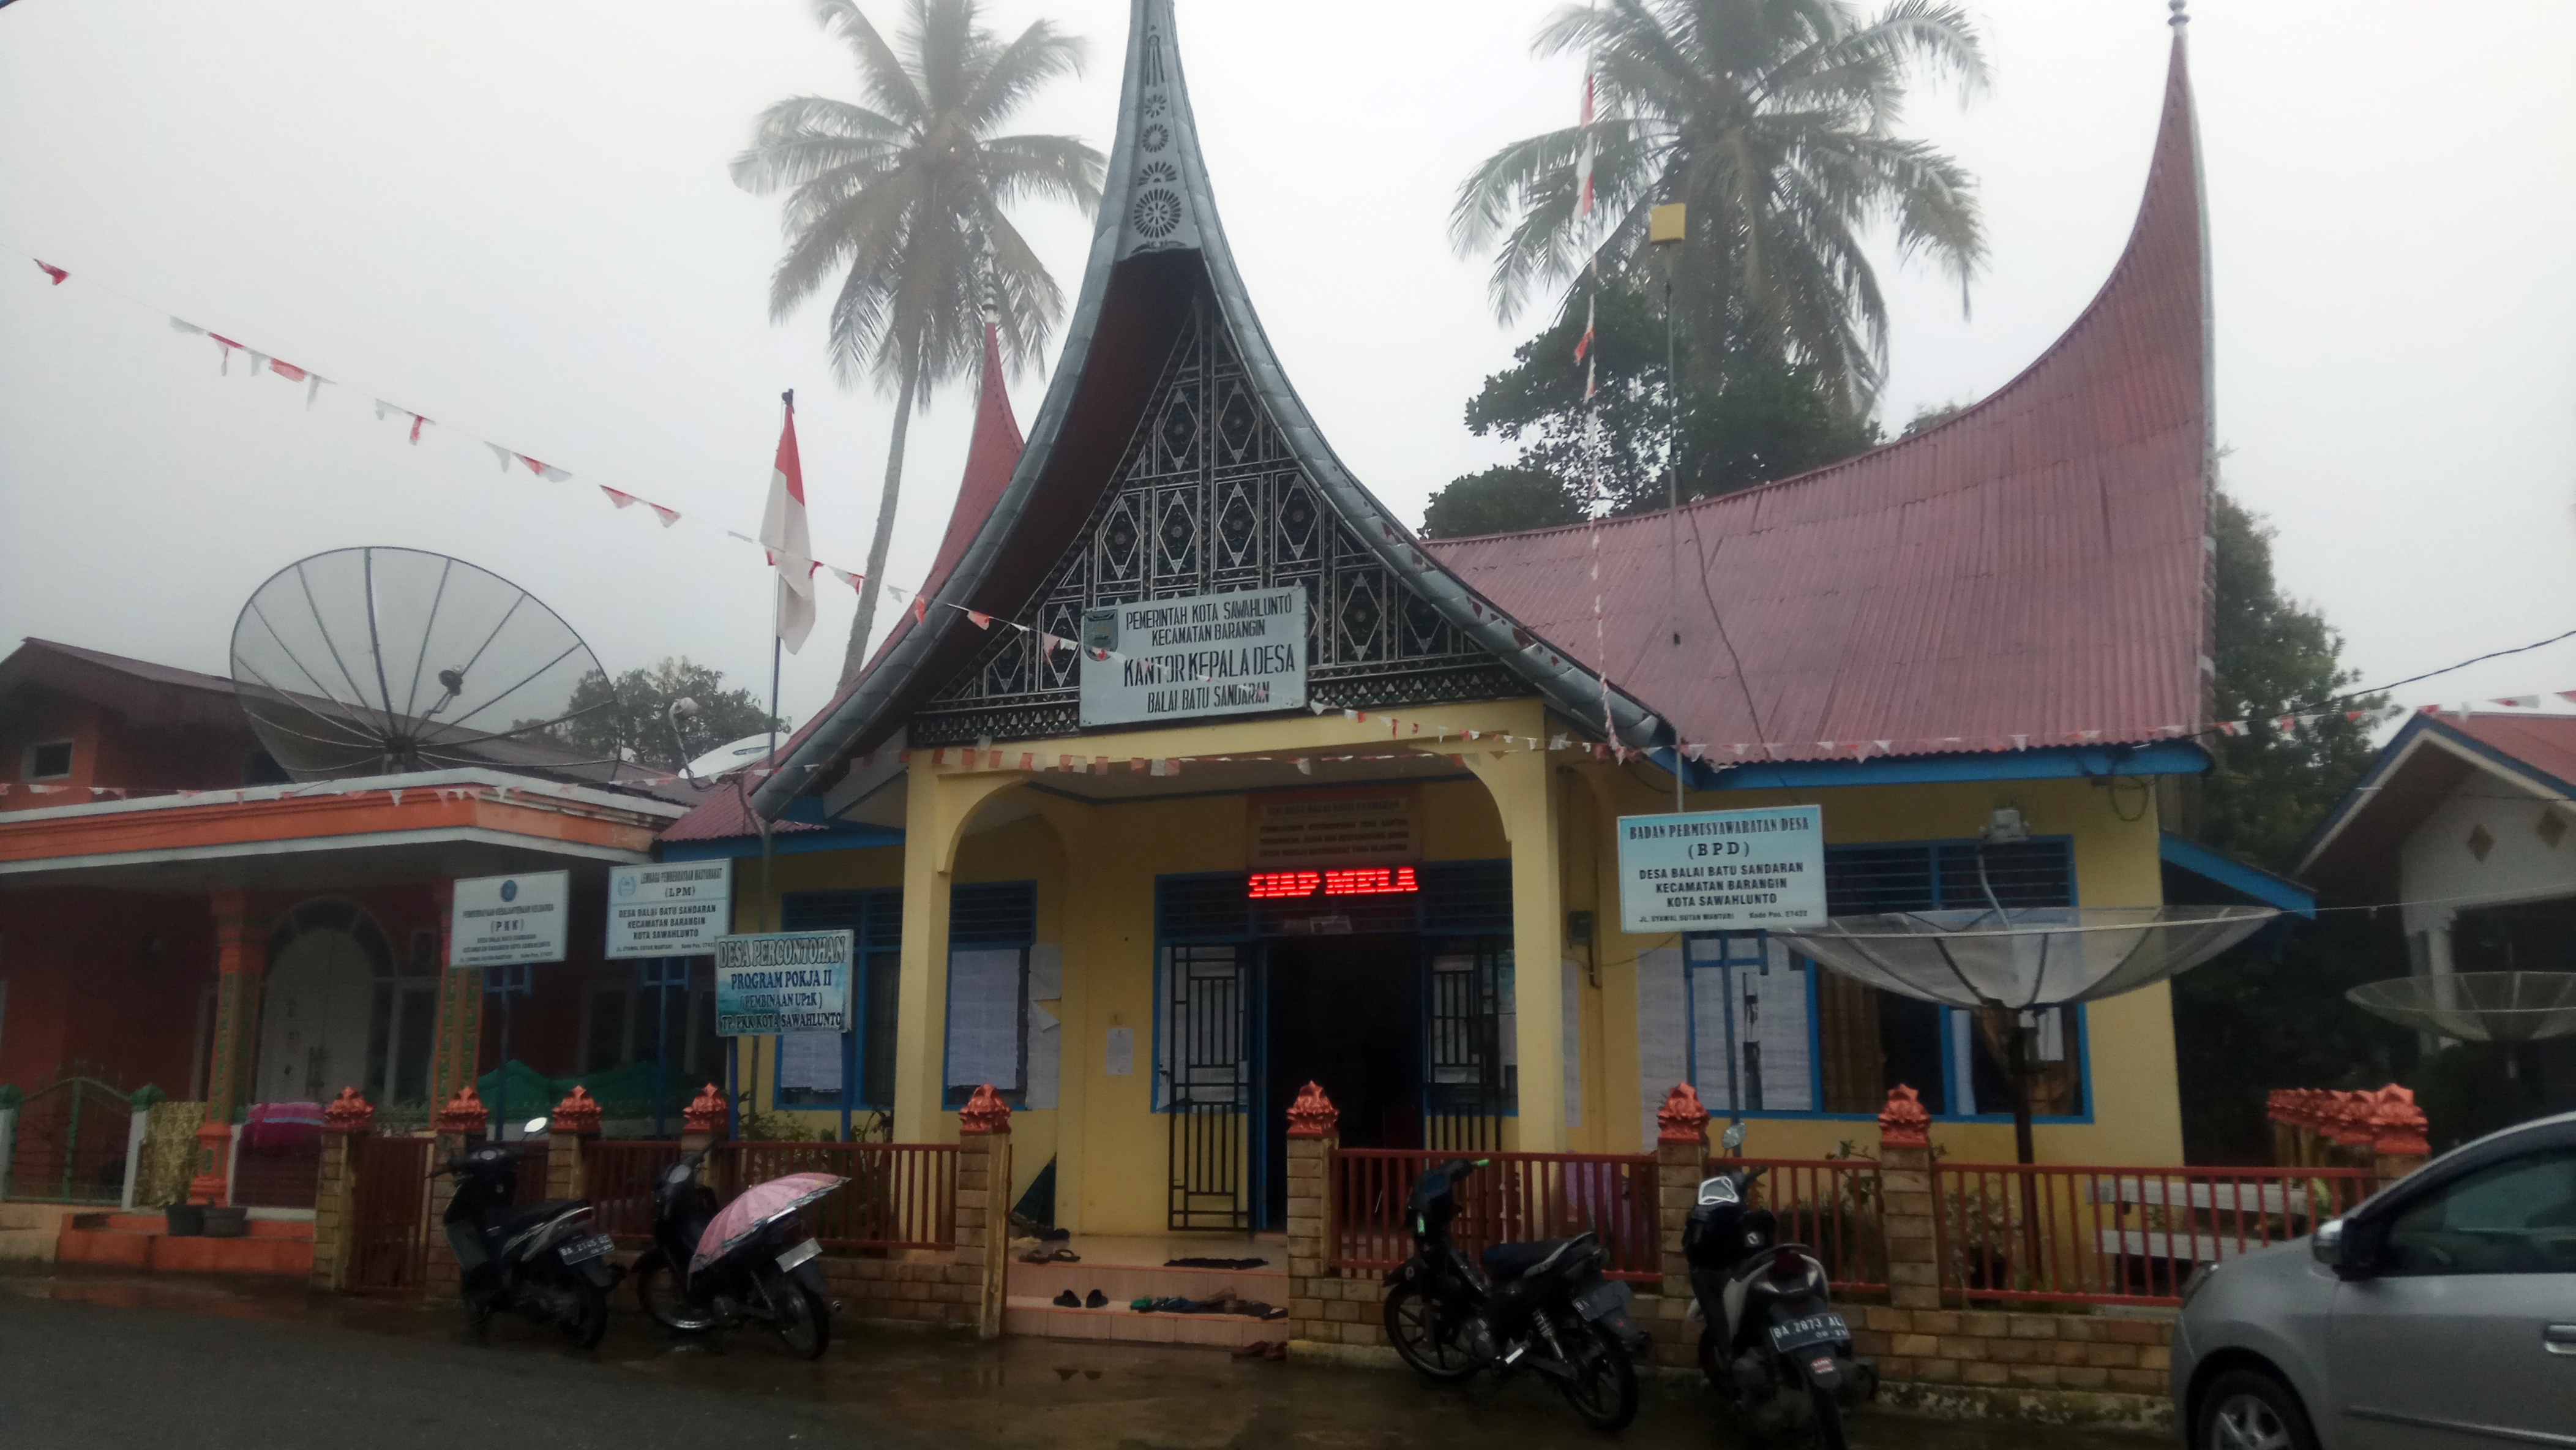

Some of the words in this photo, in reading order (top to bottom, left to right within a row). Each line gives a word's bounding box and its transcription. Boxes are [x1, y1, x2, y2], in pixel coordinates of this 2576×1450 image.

[1126, 606, 1187, 630] PEMERINTAH
[1192, 603, 1218, 622] KOTA
[1223, 593, 1292, 620] SAWAHLUNTO
[1152, 625, 1211, 646] KECAMATAN
[1215, 620, 1265, 640] BARANGIN
[1124, 655, 1185, 687] KANTOR
[1188, 648, 1249, 681] KEPALA
[1253, 644, 1295, 675] DESA
[1147, 688, 1177, 713] BALAI
[1182, 686, 1209, 710] BATU
[1214, 681, 1270, 706] SANDARAN
[1630, 824, 1664, 840] BADAN
[1669, 819, 1777, 837] PERMUSYAWARATAN
[1781, 817, 1809, 831] DESA
[1639, 869, 1668, 879] DESA
[1671, 867, 1704, 877] BALAI
[1709, 865, 1736, 876] BATU
[1741, 862, 1803, 875] SANDARAN
[1656, 881, 1723, 893] KECAMATAN
[1728, 878, 1786, 890] BARANGIN
[679, 905, 716, 914] SANDARAN
[1667, 897, 1695, 907] KOTA
[1699, 893, 1777, 906] SAWAHLUNTO
[628, 918, 667, 928] KECAMATAN
[670, 917, 705, 926] BARANGIN
[653, 930, 698, 938] SAWAHLUNTO
[718, 941, 750, 968] DESA
[752, 936, 845, 966] PERCONTOHAN
[731, 971, 783, 990] PROGRAM
[785, 970, 820, 988] POKJA
[823, 969, 831, 985] II
[721, 1016, 734, 1030] TP.
[736, 1016, 754, 1029] PKK
[757, 1014, 779, 1028] KOTA
[781, 1012, 841, 1027] SAWAHLUNTO
[1773, 1325, 1789, 1339] BA
[1829, 1317, 1841, 1326] AL
